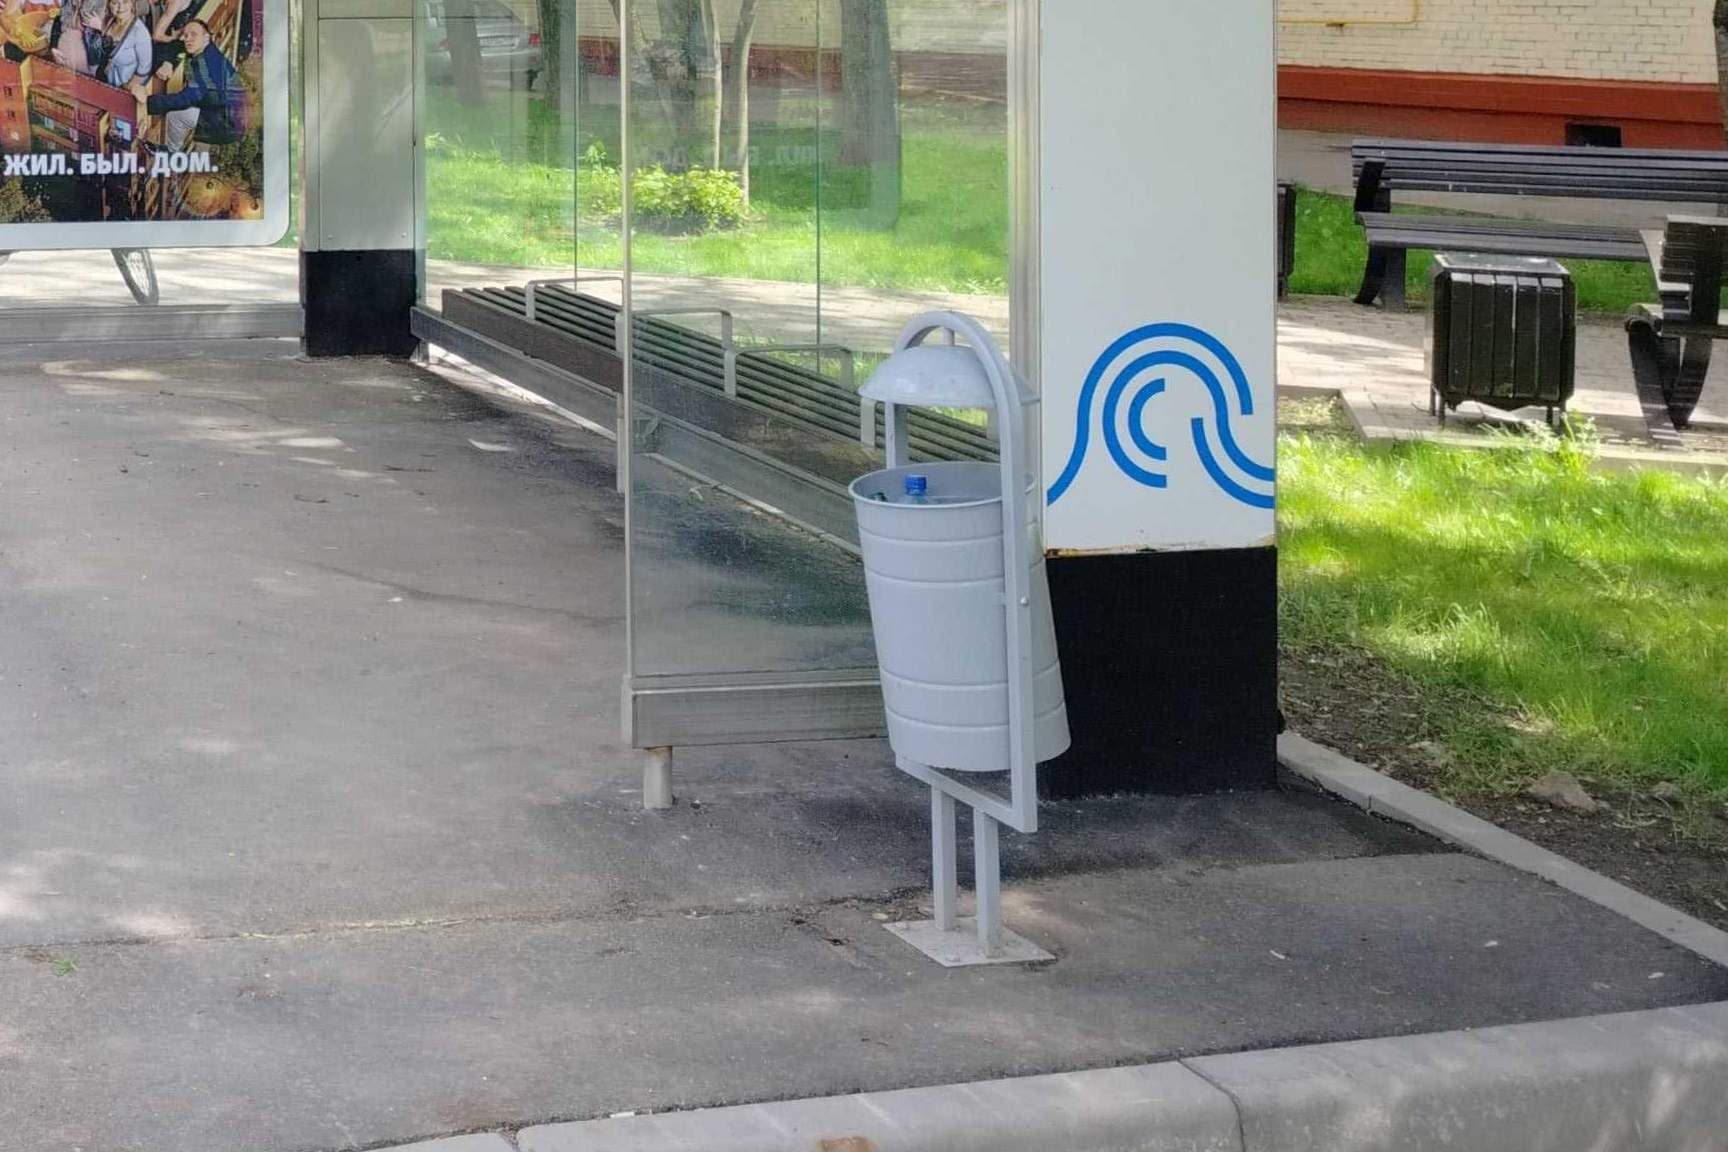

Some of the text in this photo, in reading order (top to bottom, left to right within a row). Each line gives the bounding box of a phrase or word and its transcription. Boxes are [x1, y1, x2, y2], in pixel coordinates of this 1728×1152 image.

[3, 151, 219, 179] ЖИЛ. БЫЛ. ДОМ.
